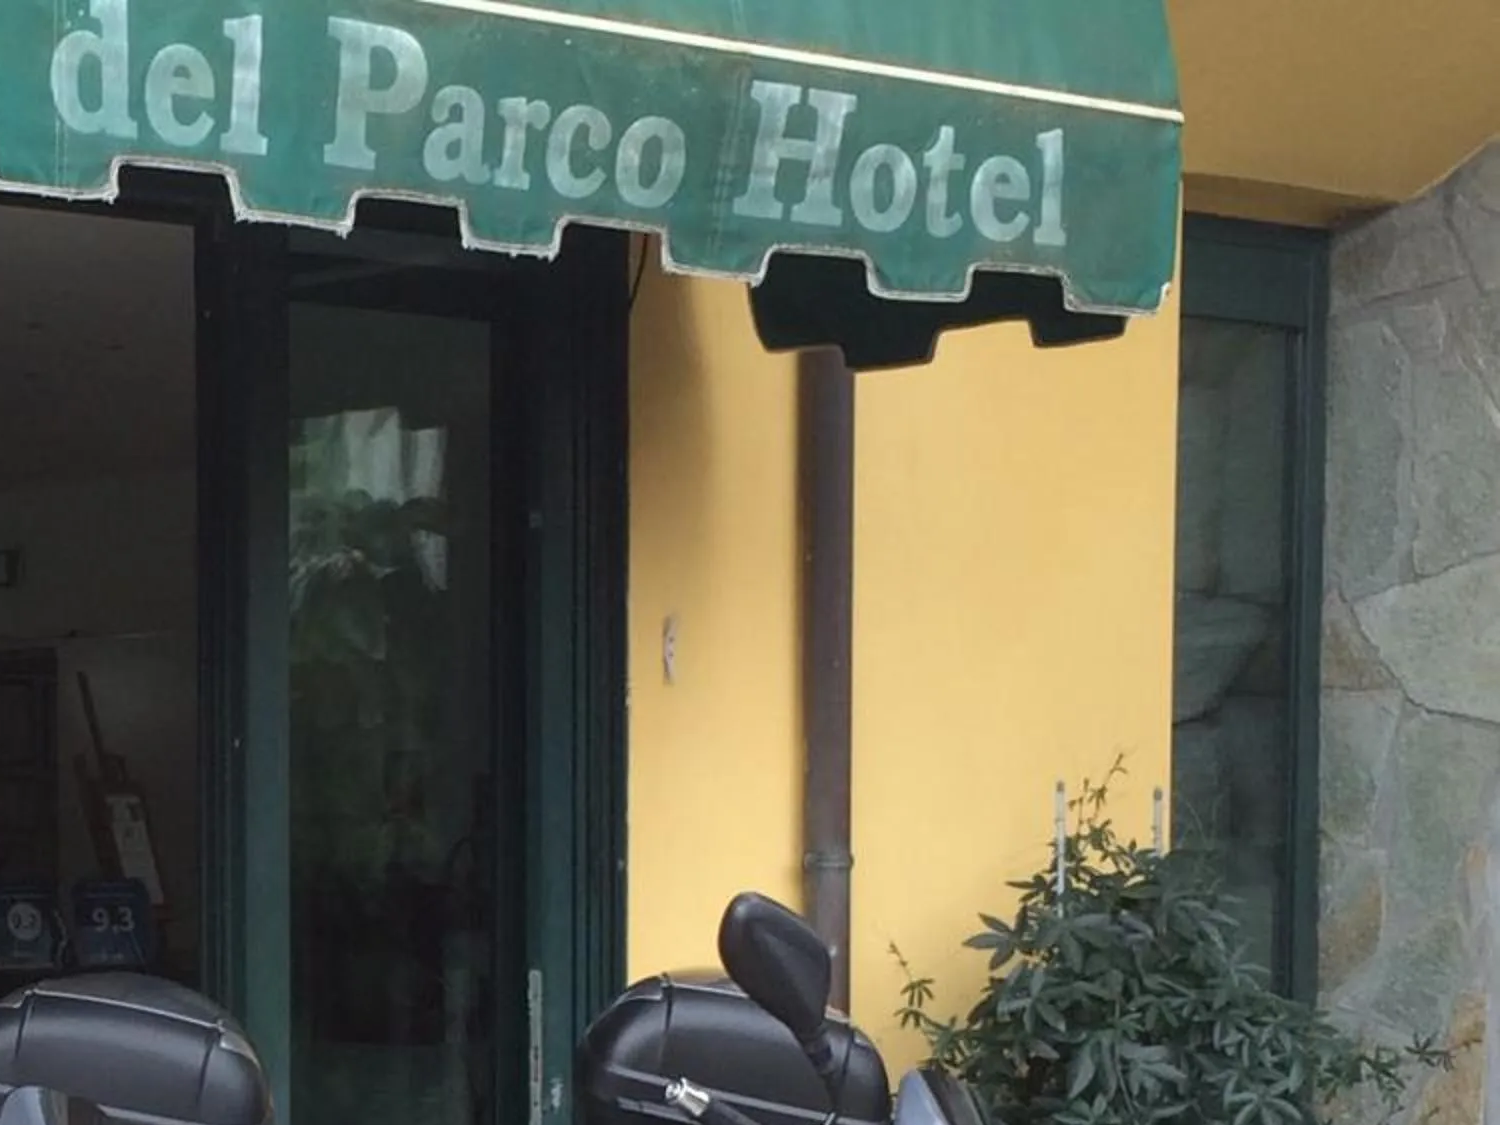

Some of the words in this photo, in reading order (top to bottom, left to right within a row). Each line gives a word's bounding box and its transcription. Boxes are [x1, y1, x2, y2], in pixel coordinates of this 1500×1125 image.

[51, 0, 269, 157] del
[322, 15, 688, 210] Parco
[731, 78, 1067, 247] Hotel
